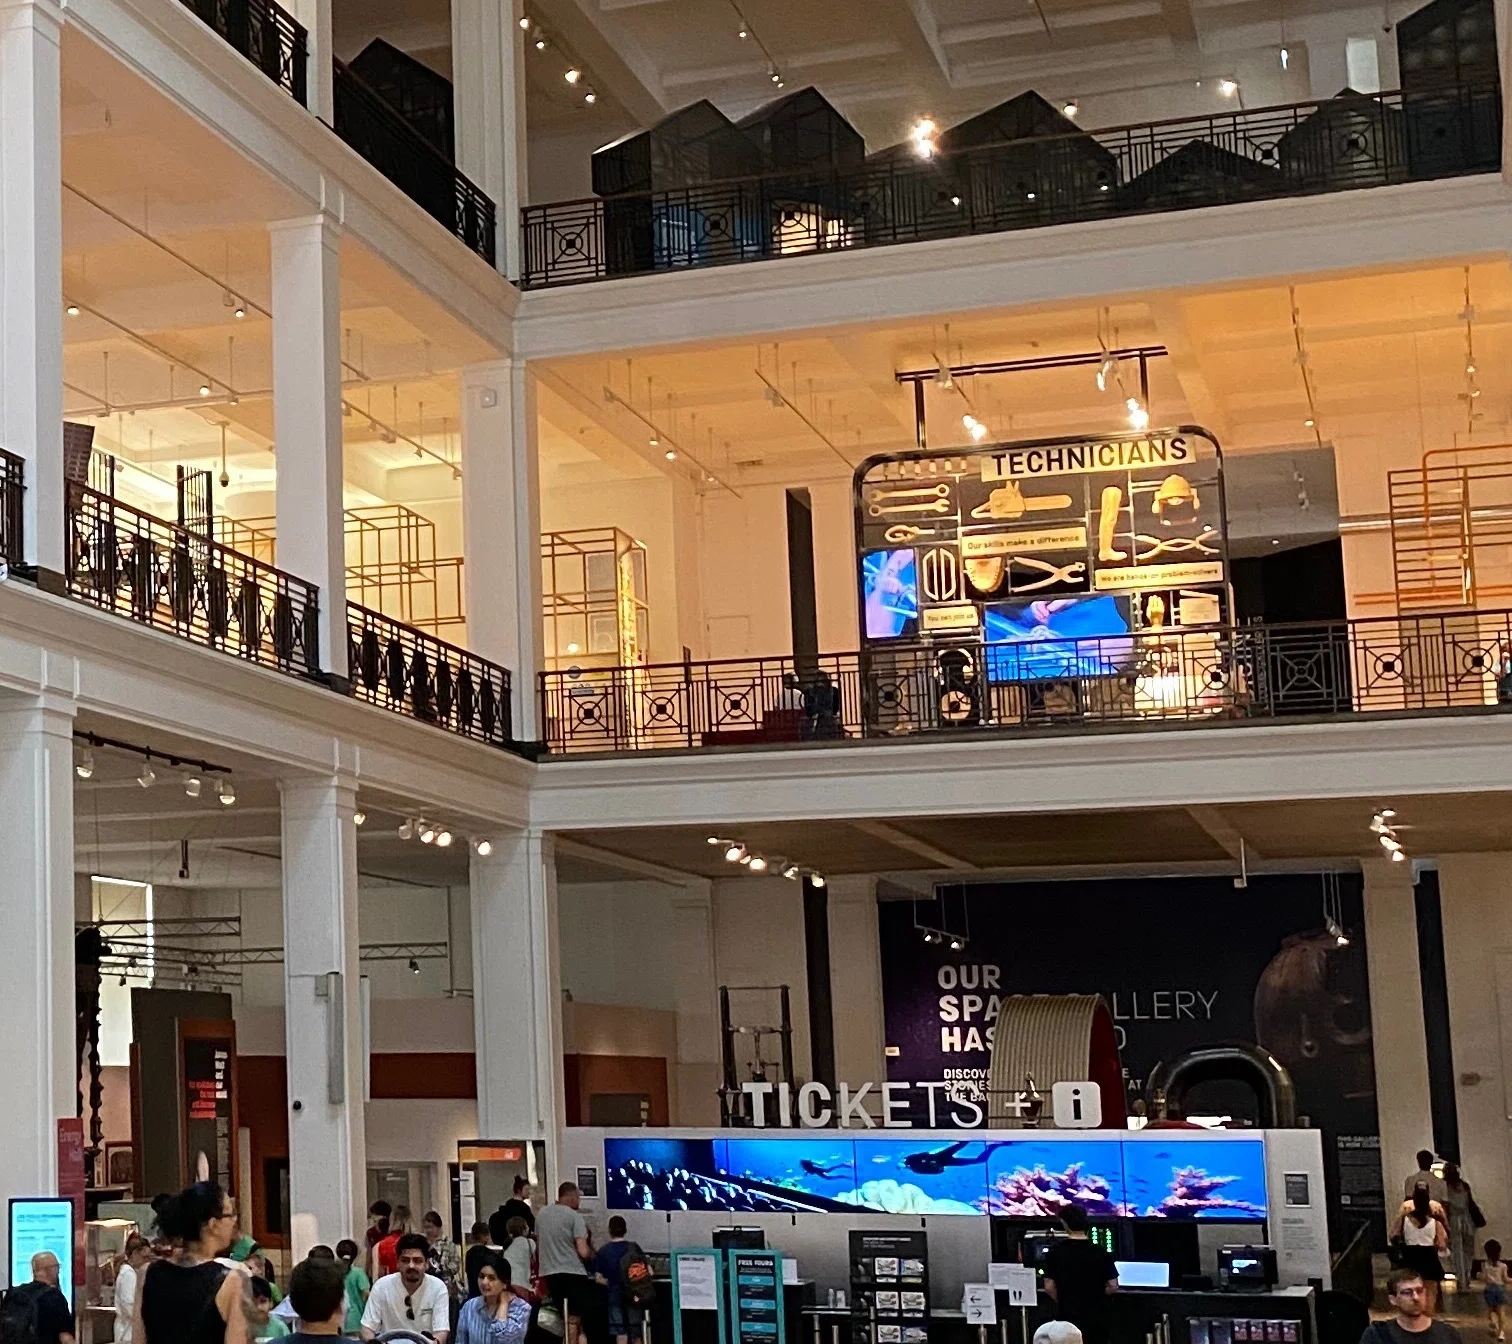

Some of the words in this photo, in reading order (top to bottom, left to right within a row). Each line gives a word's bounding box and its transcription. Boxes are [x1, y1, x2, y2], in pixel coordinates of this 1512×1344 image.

[991, 437, 1188, 476] TECHNICIANS
[968, 542, 982, 550] Our
[984, 540, 1005, 549] skills
[1006, 538, 1028, 547] make
[1036, 535, 1080, 545] difference
[938, 964, 1001, 990] OUR
[939, 994, 1003, 1022] SPA
[1112, 990, 1218, 1020] LLERY
[941, 1026, 994, 1053] HA
[943, 1068, 989, 1079] DISCOV
[1128, 1079, 1144, 1090] AT
[742, 1081, 984, 1128] TICKETS
[970, 1092, 989, 1102] BA
